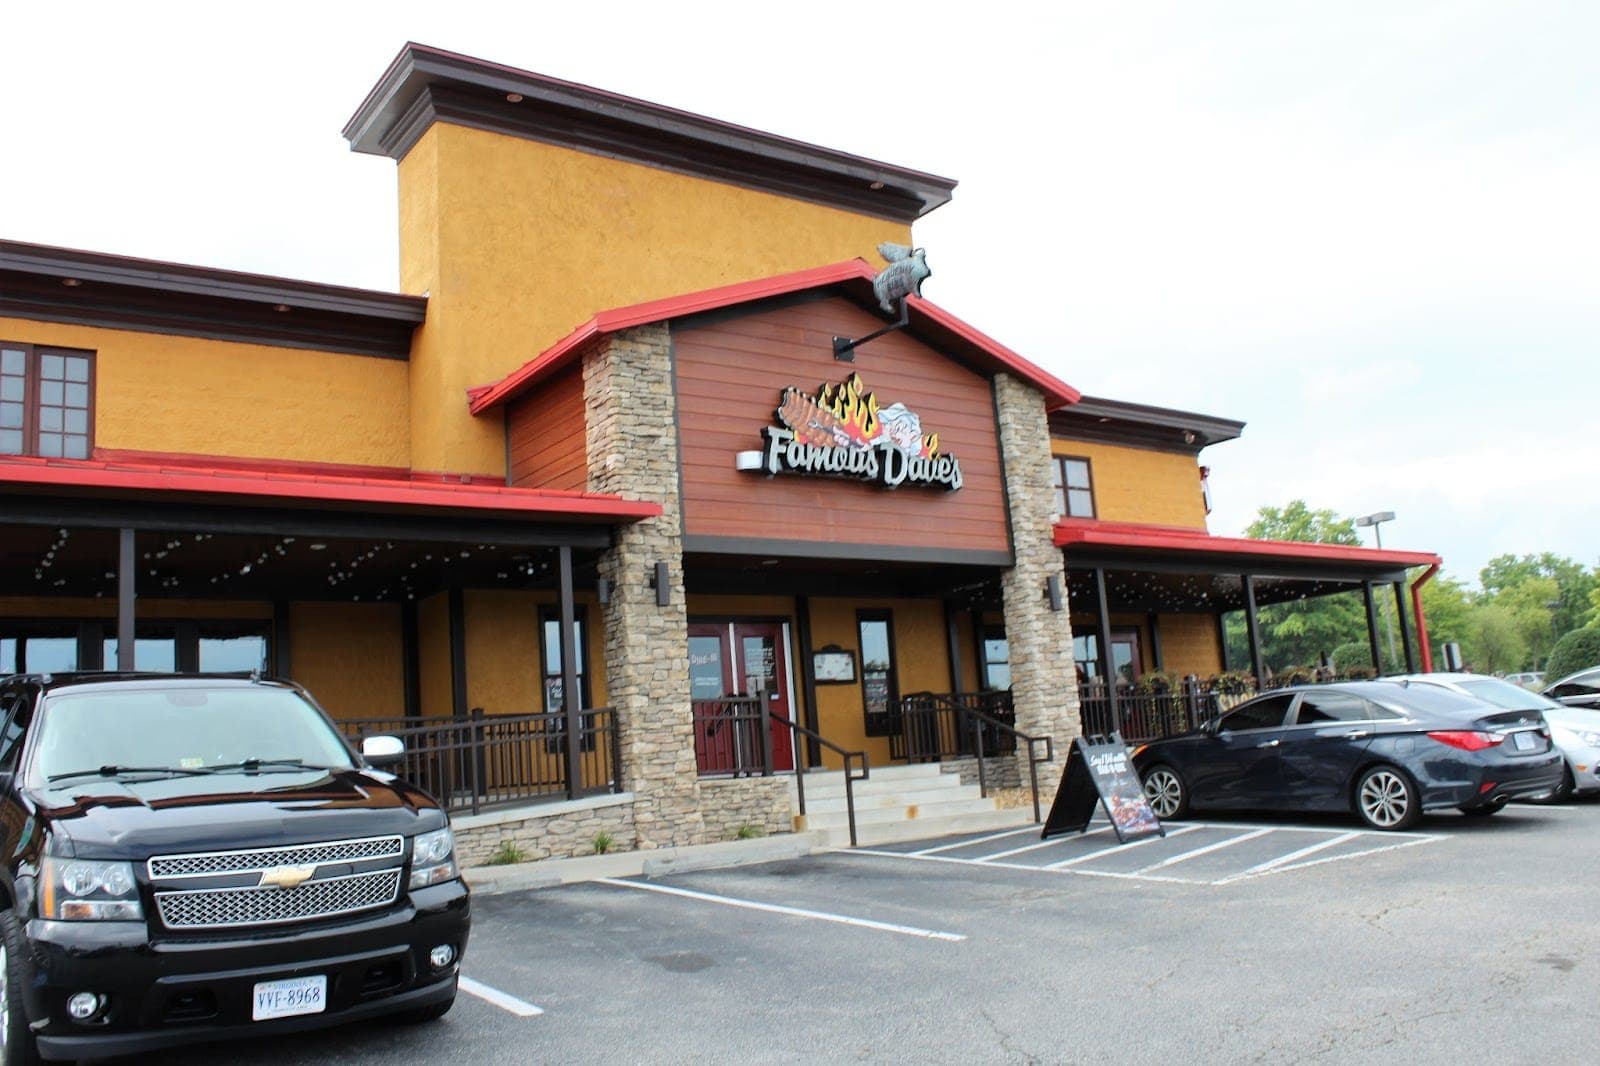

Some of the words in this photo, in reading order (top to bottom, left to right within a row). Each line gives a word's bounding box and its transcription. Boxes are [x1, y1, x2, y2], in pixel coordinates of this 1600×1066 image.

[768, 426, 879, 480] Famous
[880, 441, 964, 490] Dave's
[258, 987, 320, 1010] VVF-8968
